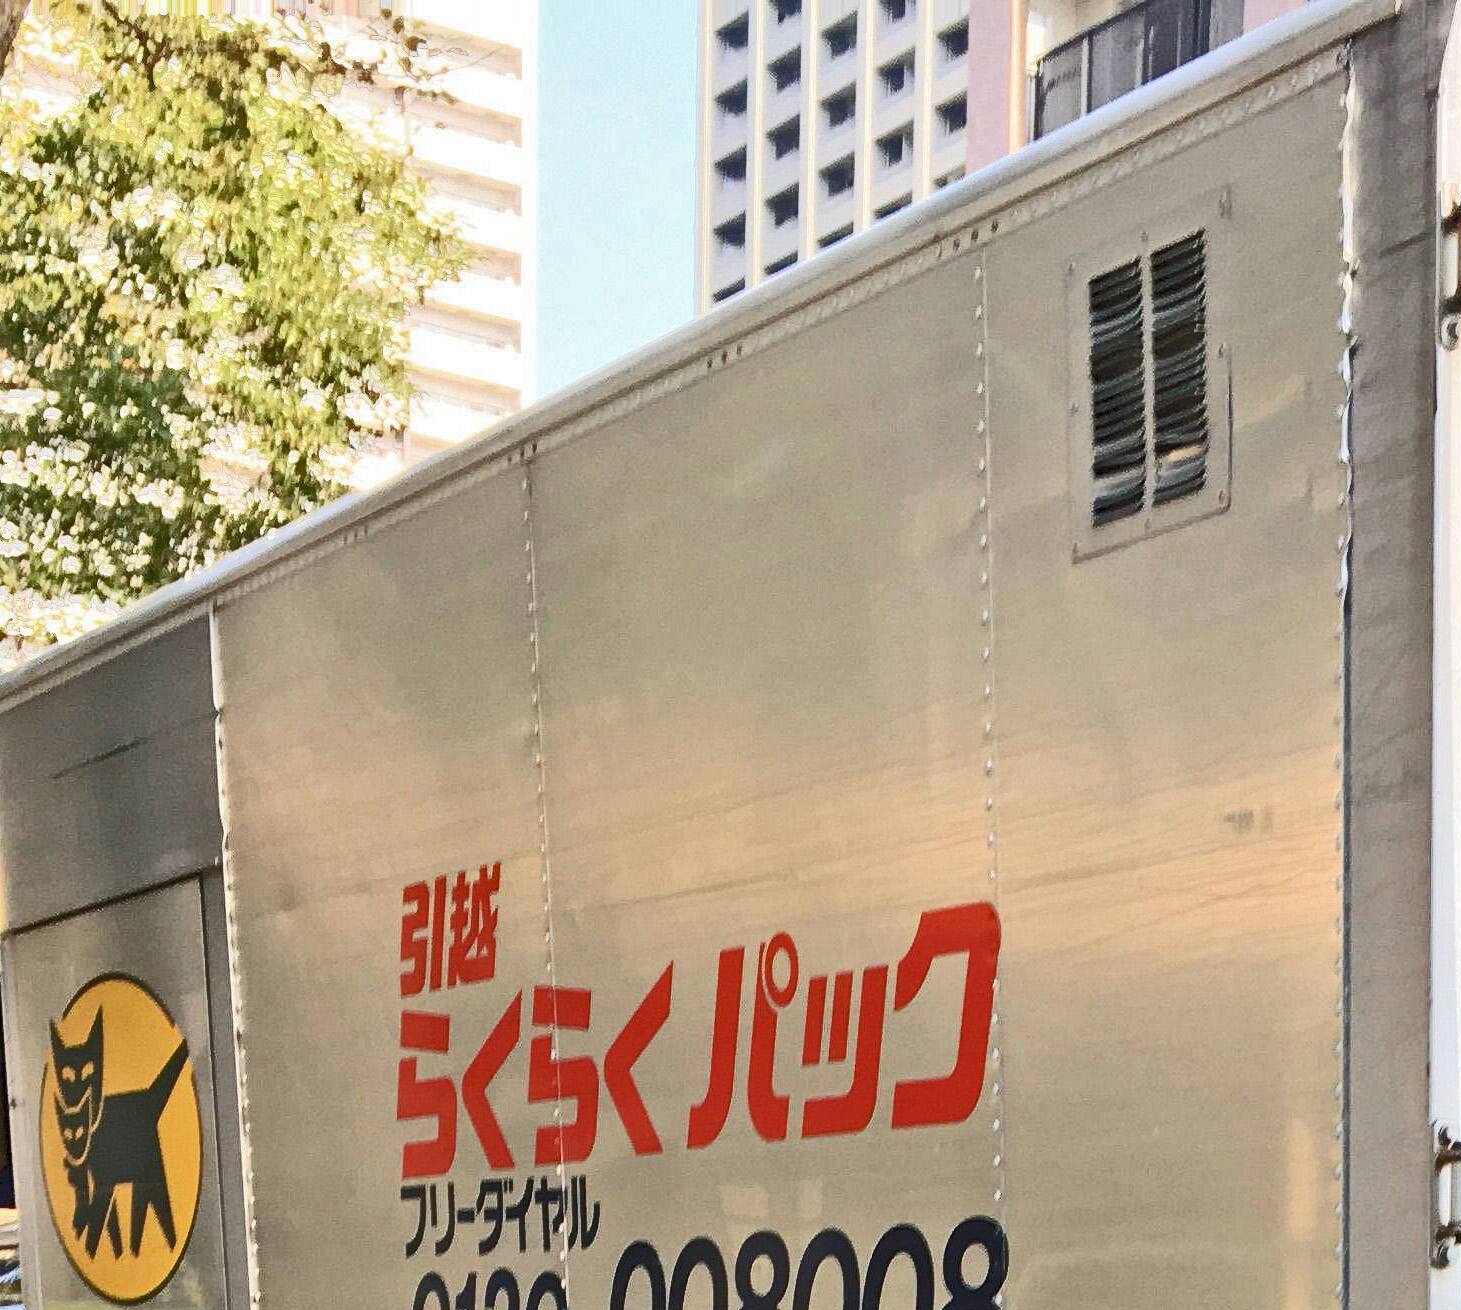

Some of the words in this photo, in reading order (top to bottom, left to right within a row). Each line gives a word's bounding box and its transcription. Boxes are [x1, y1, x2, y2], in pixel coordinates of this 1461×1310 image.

[400, 861, 502, 996] 引越
[400, 1175, 600, 1259] フリーダイヤル
